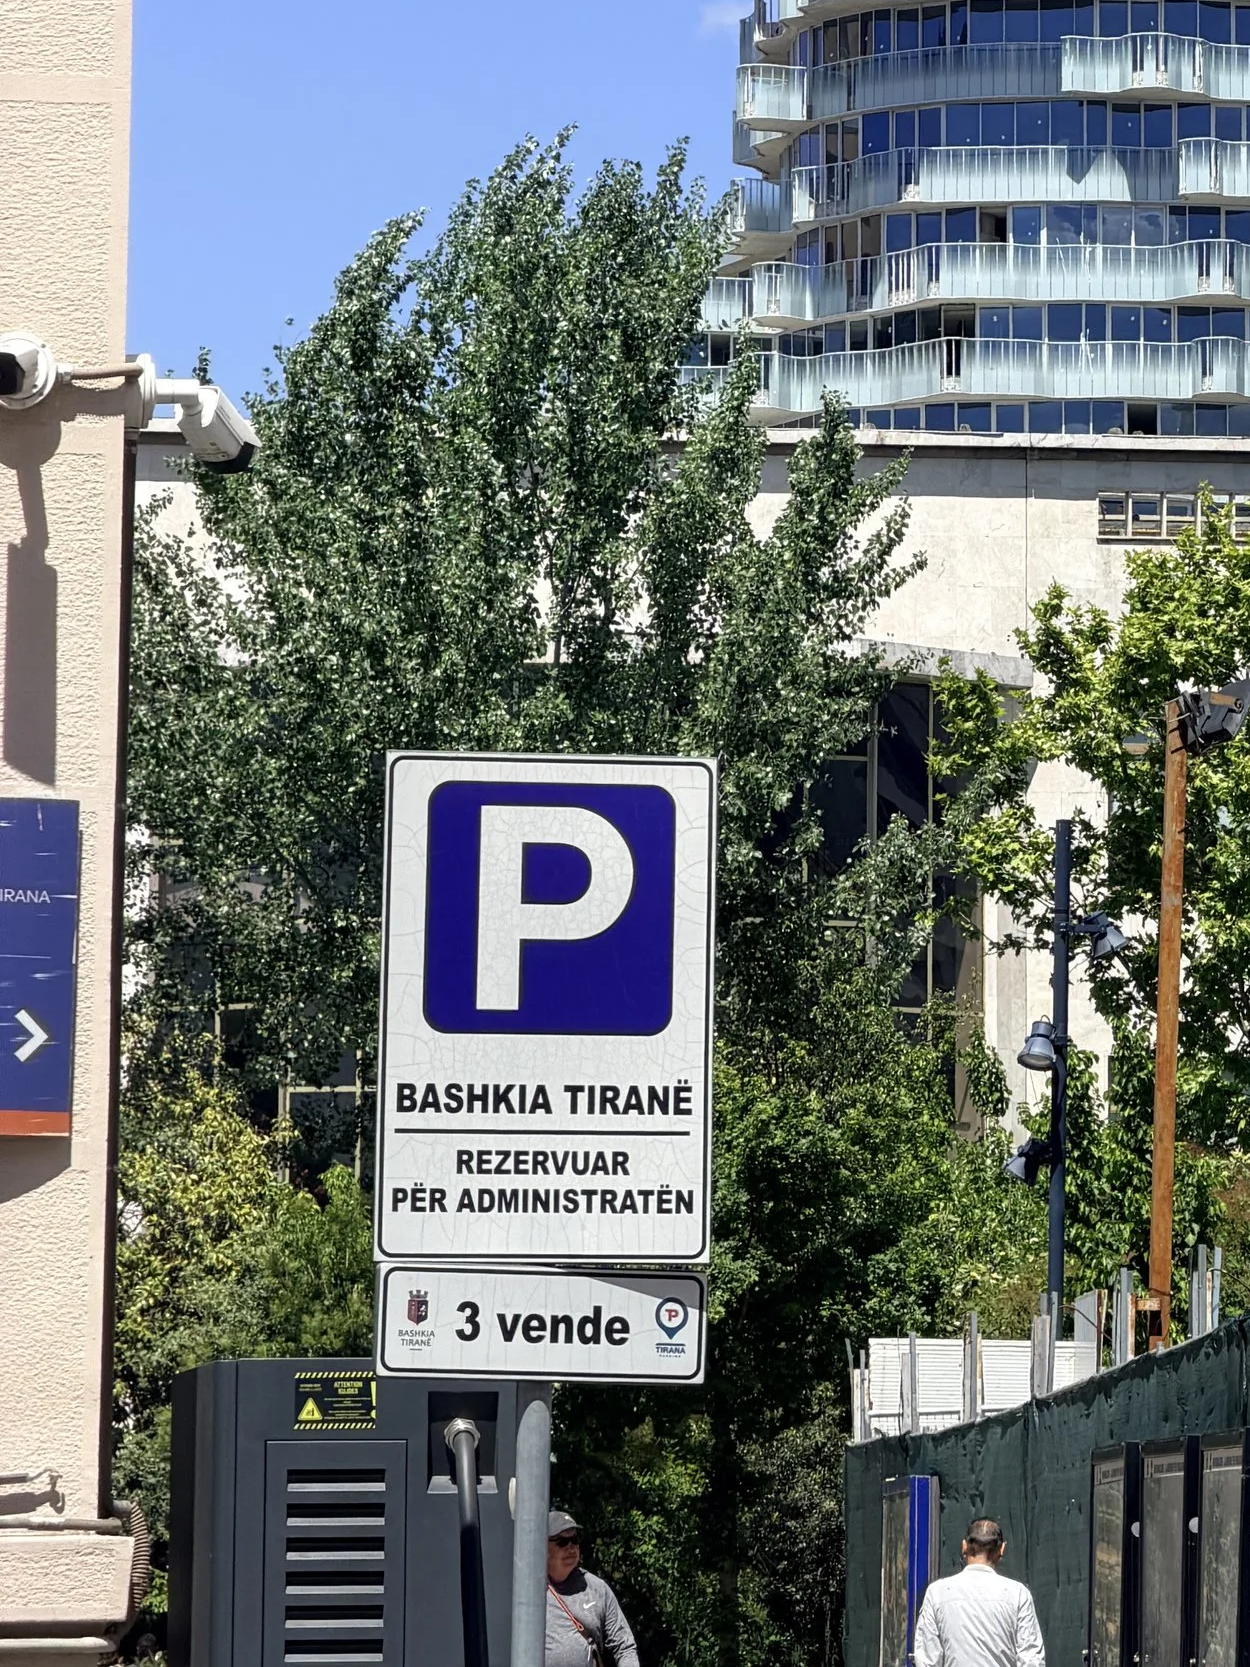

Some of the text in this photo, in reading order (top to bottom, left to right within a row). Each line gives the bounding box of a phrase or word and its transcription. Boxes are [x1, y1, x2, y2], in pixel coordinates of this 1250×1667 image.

[0, 888, 51, 904] IRANA
[474, 804, 634, 1011] P
[396, 1078, 693, 1116] BASHKIA TIRANË
[456, 1149, 630, 1176] REZERVUAR
[391, 1181, 694, 1215] PËR ADMINISTRATËN
[398, 1329, 436, 1338] BASHKIA
[455, 1300, 630, 1346] 3 vende
[400, 1337, 432, 1347] TIRANË
[655, 1346, 686, 1354] TIRANA
